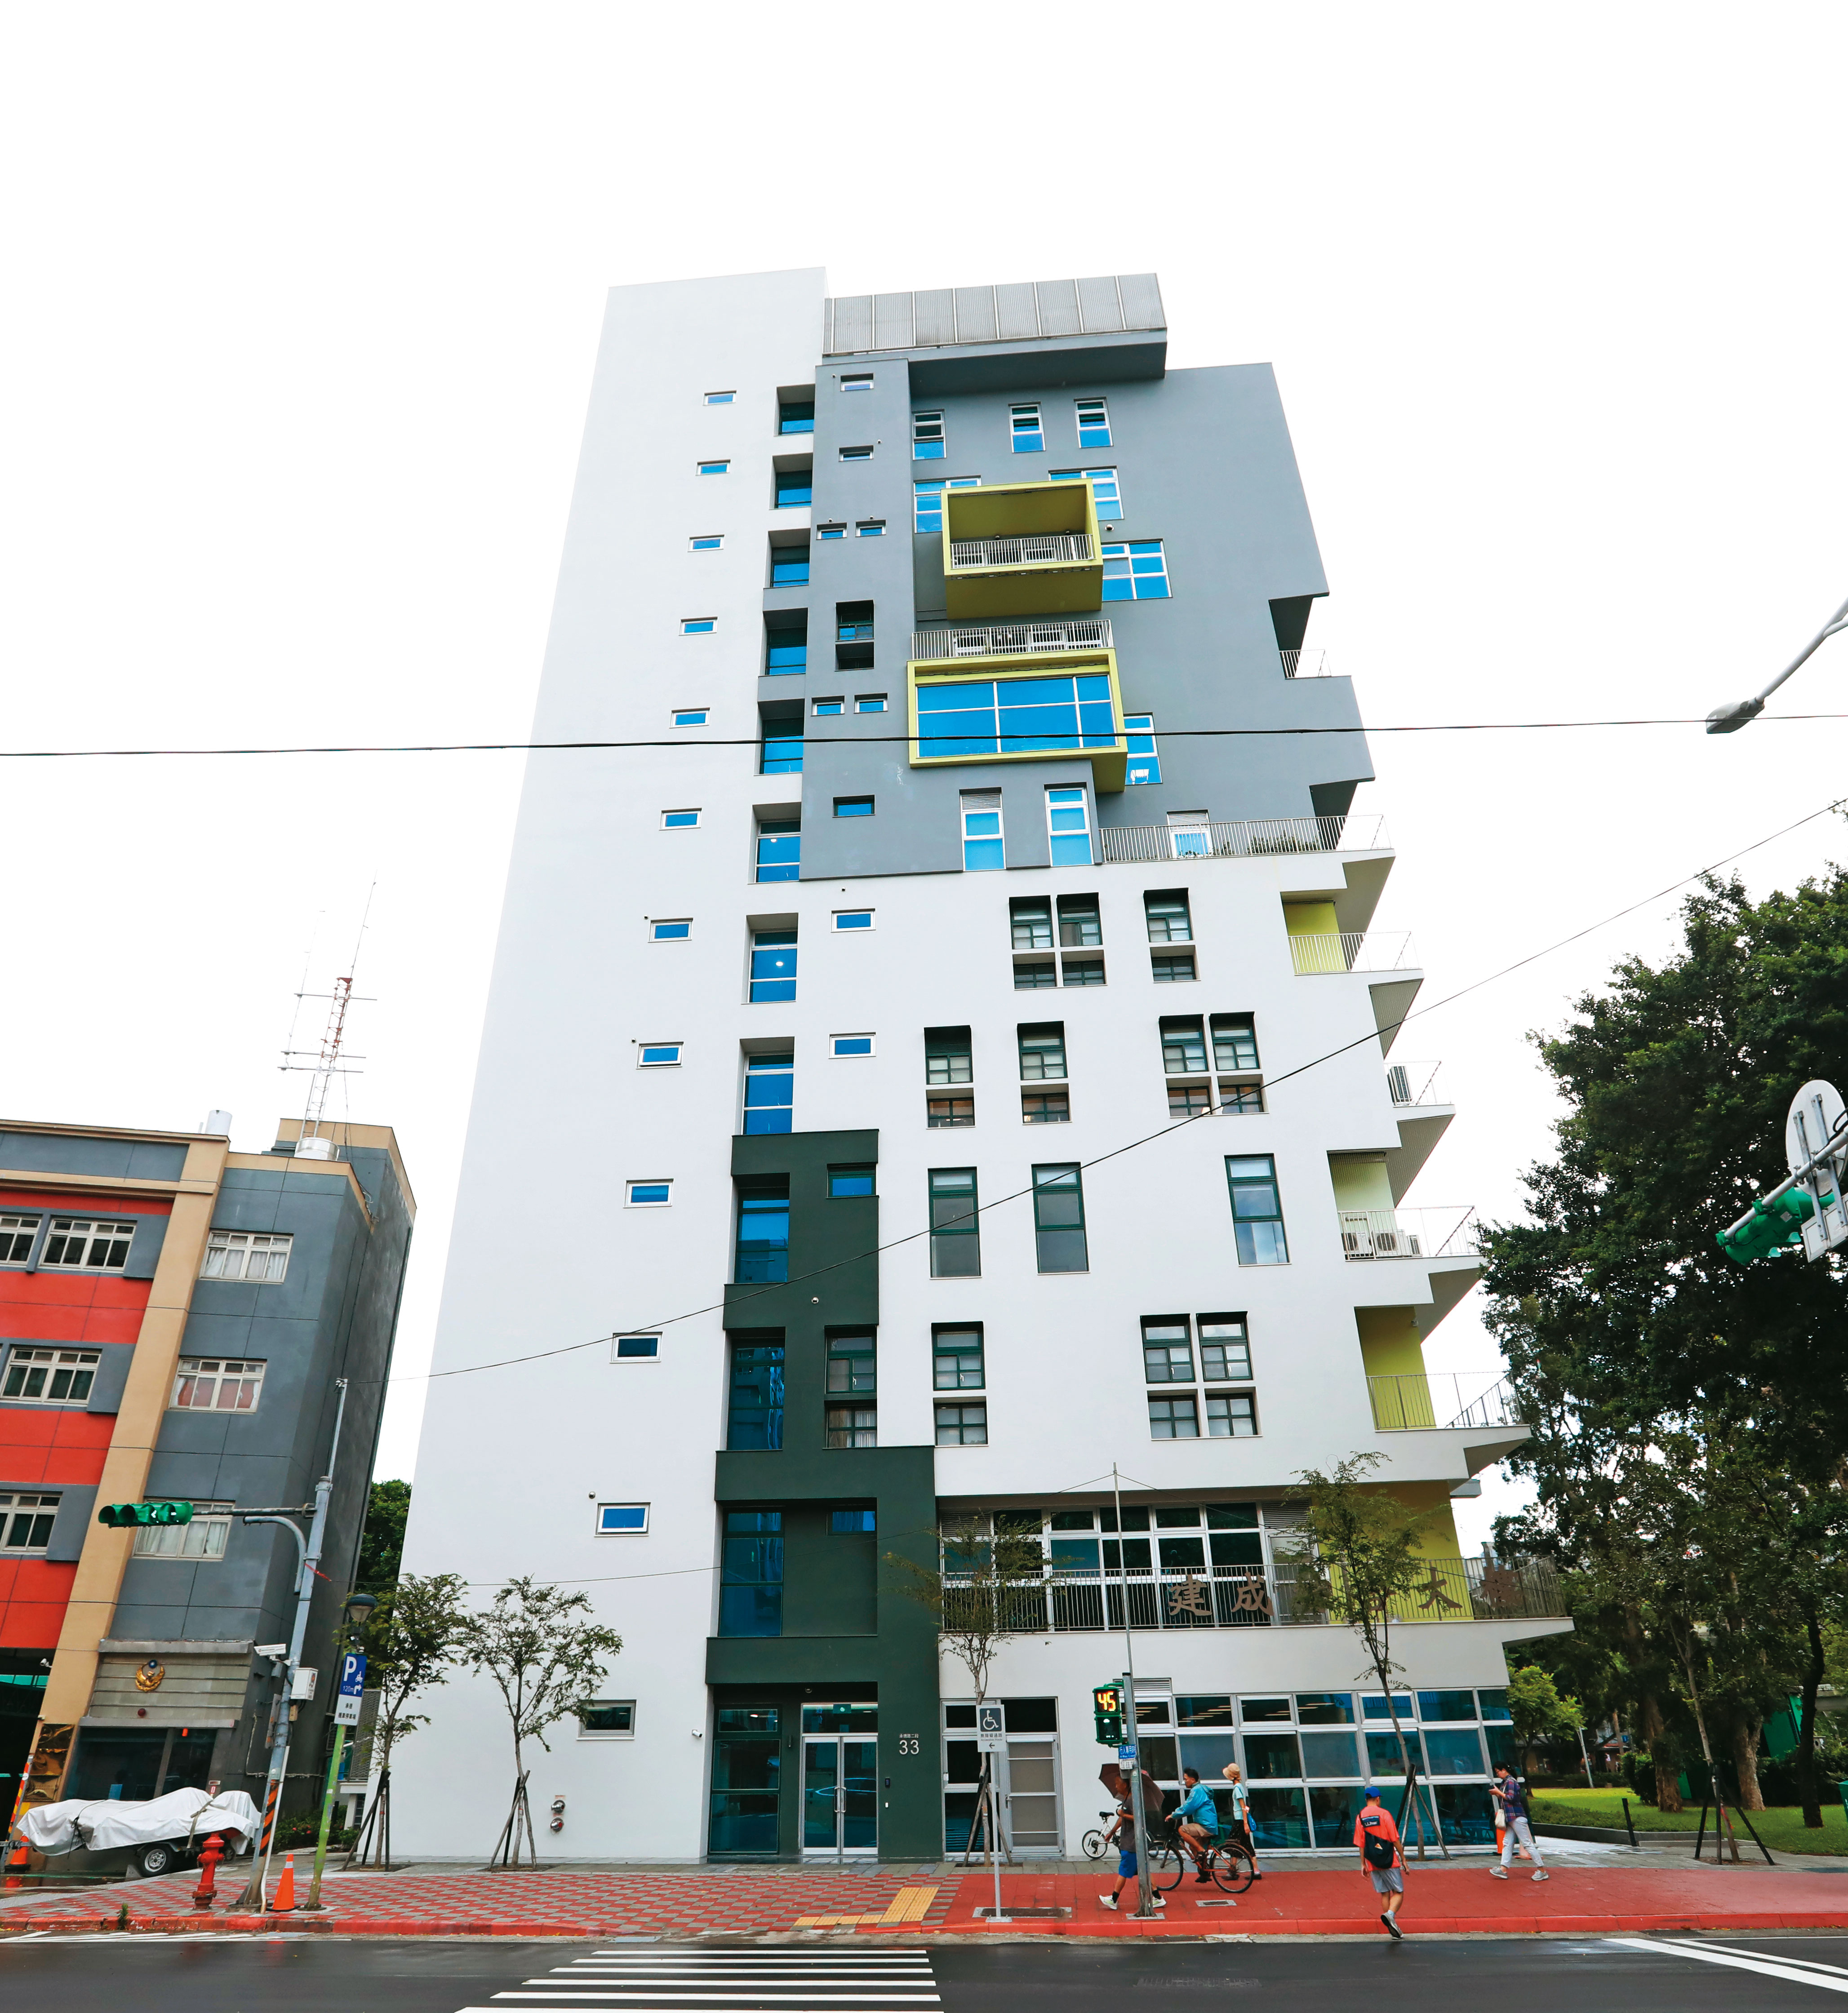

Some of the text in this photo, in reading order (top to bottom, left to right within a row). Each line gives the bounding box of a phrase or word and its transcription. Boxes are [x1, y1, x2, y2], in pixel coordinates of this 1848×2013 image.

[343, 1656, 357, 1681] P
[1097, 1691, 1116, 1711] 45
[899, 1740, 919, 1755] 33
